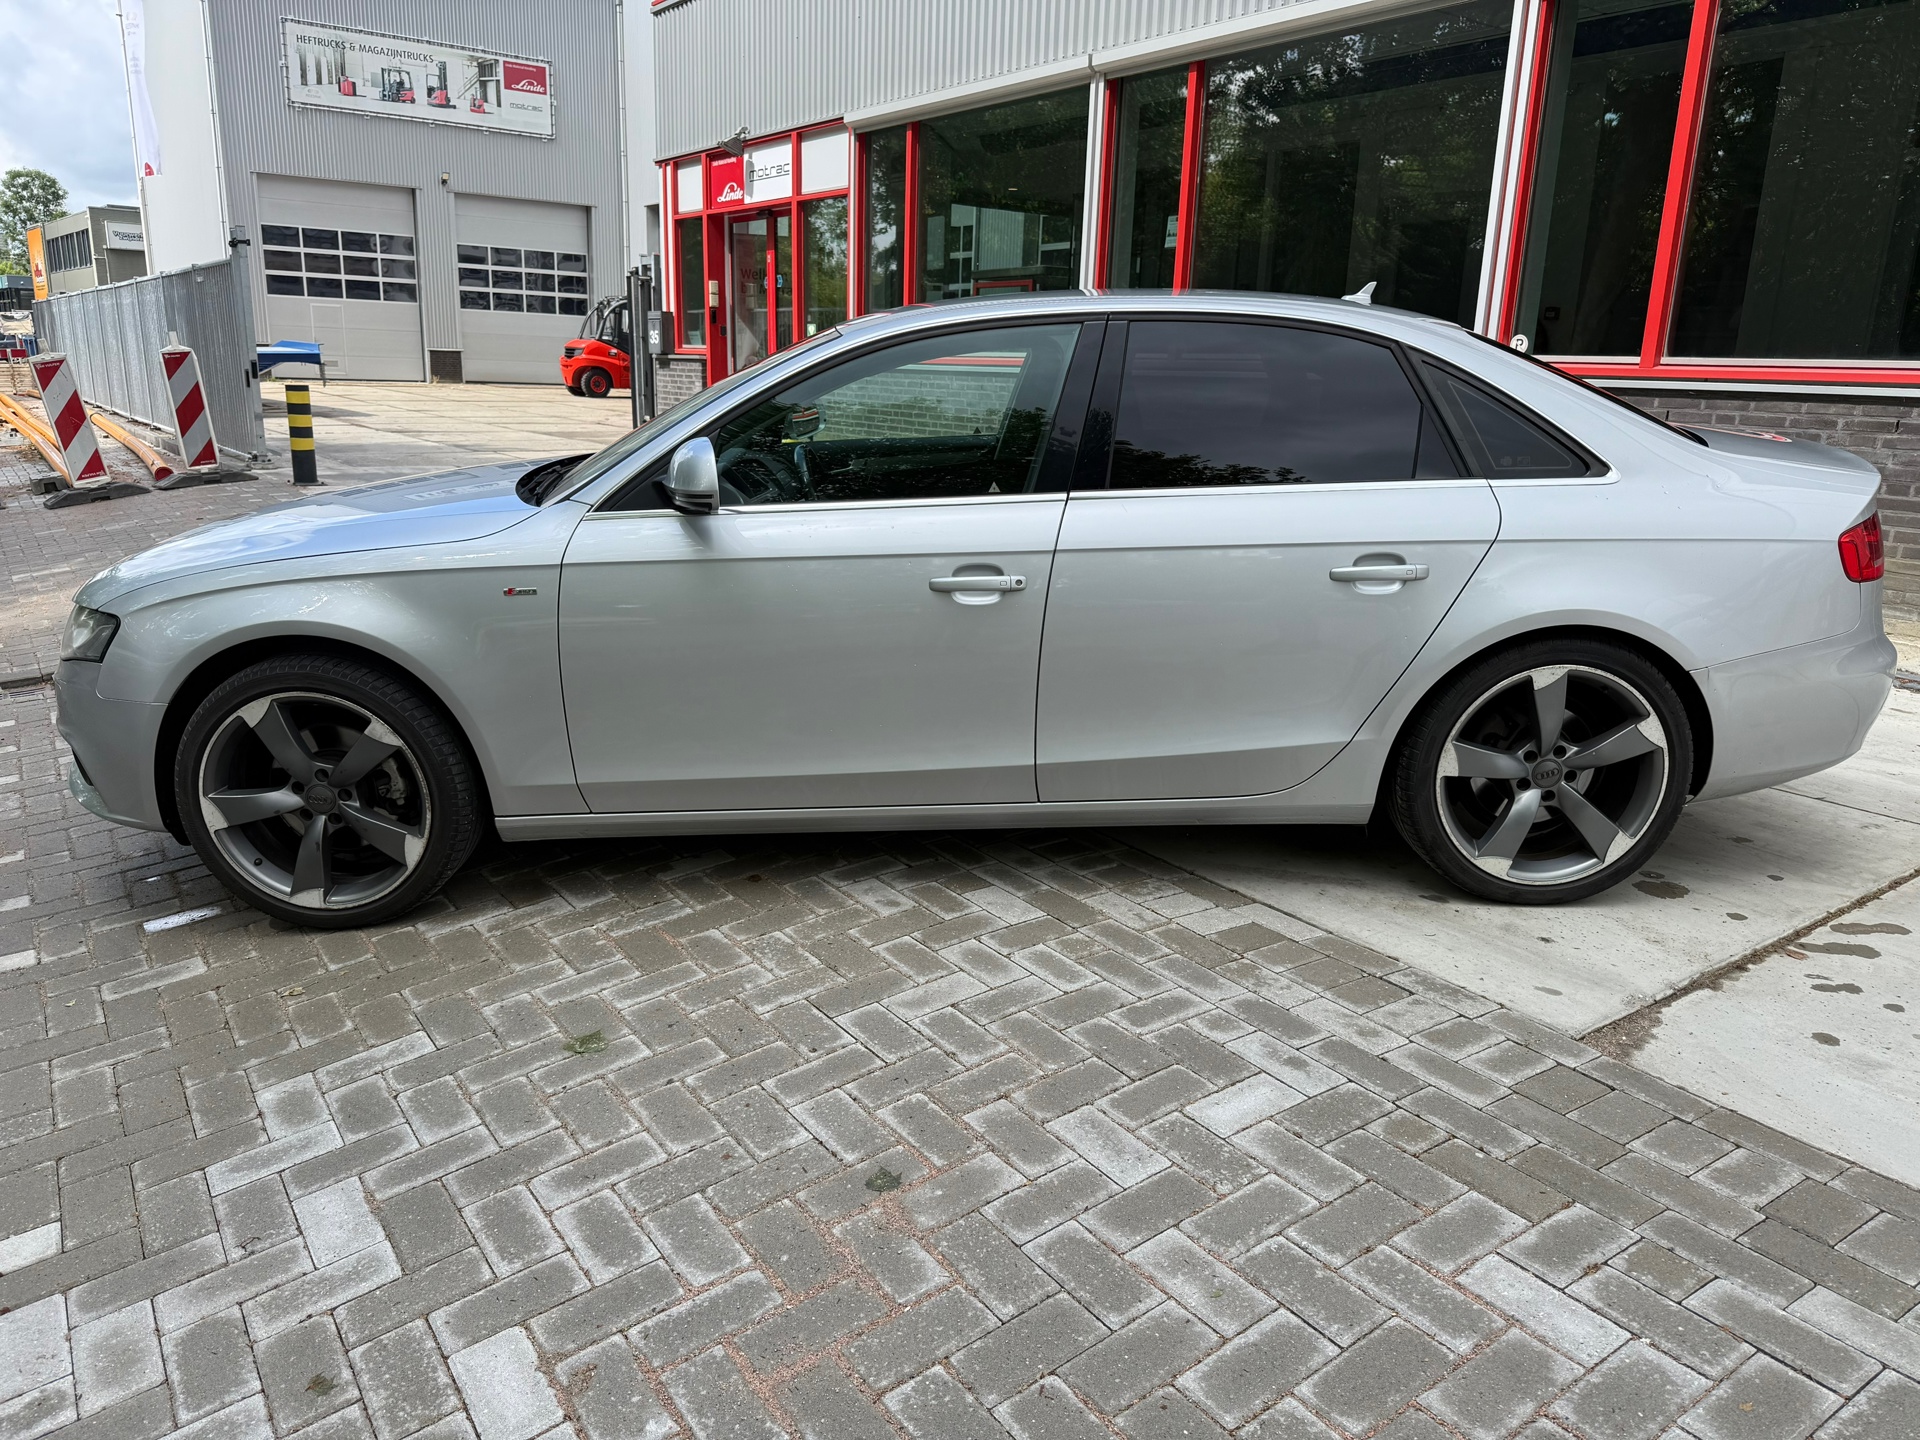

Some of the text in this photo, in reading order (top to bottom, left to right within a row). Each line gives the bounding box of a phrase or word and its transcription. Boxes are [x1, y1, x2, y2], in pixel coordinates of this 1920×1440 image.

[296, 34, 434, 63] HEFTRUCKS & MAGAZIJNTRUCKS
[511, 79, 545, 93] Linde
[749, 163, 790, 180] motrac
[717, 182, 744, 203] Linde
[649, 330, 659, 345] 35
